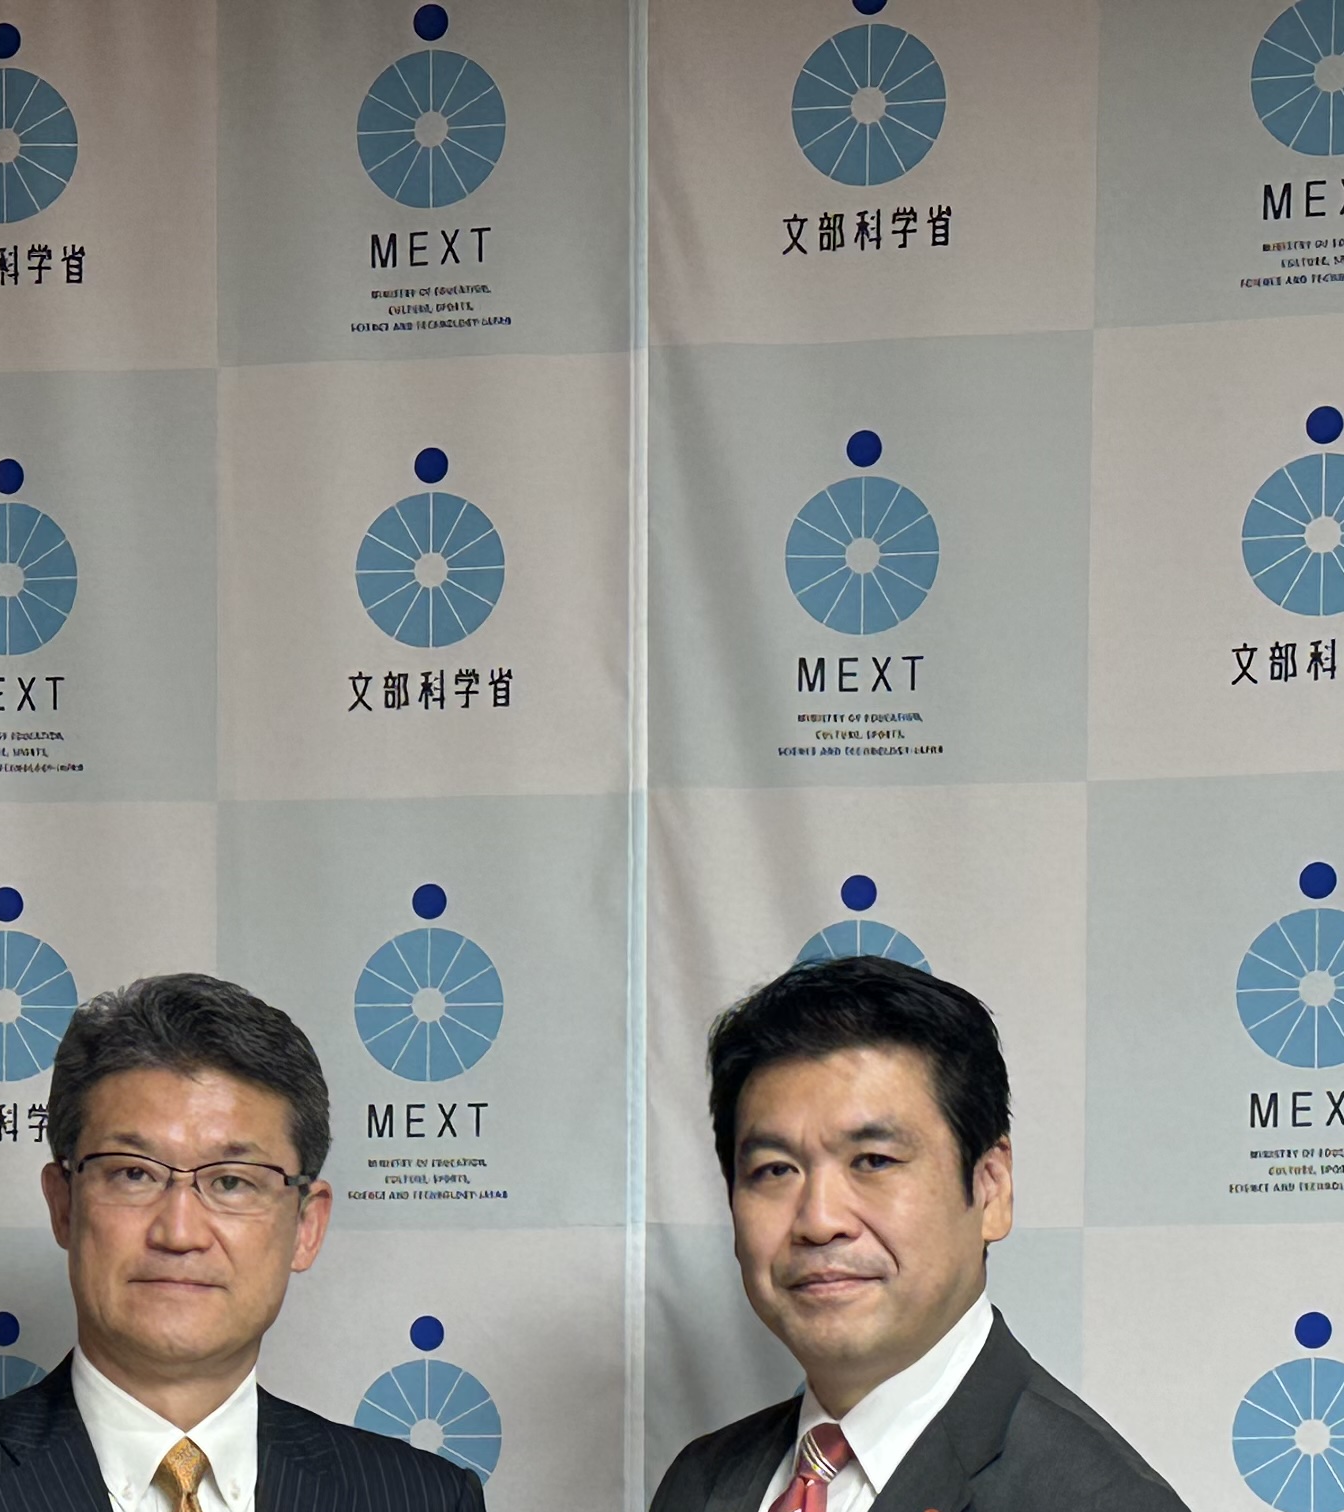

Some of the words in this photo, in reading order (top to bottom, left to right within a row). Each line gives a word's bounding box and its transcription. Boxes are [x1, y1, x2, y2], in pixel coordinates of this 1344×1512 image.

[371, 227, 491, 269] MEXT
[783, 205, 951, 255] 文部科学省
[348, 667, 513, 711] 文部科学省
[798, 656, 924, 692] MEXT
[368, 1103, 488, 1138] MEXT
